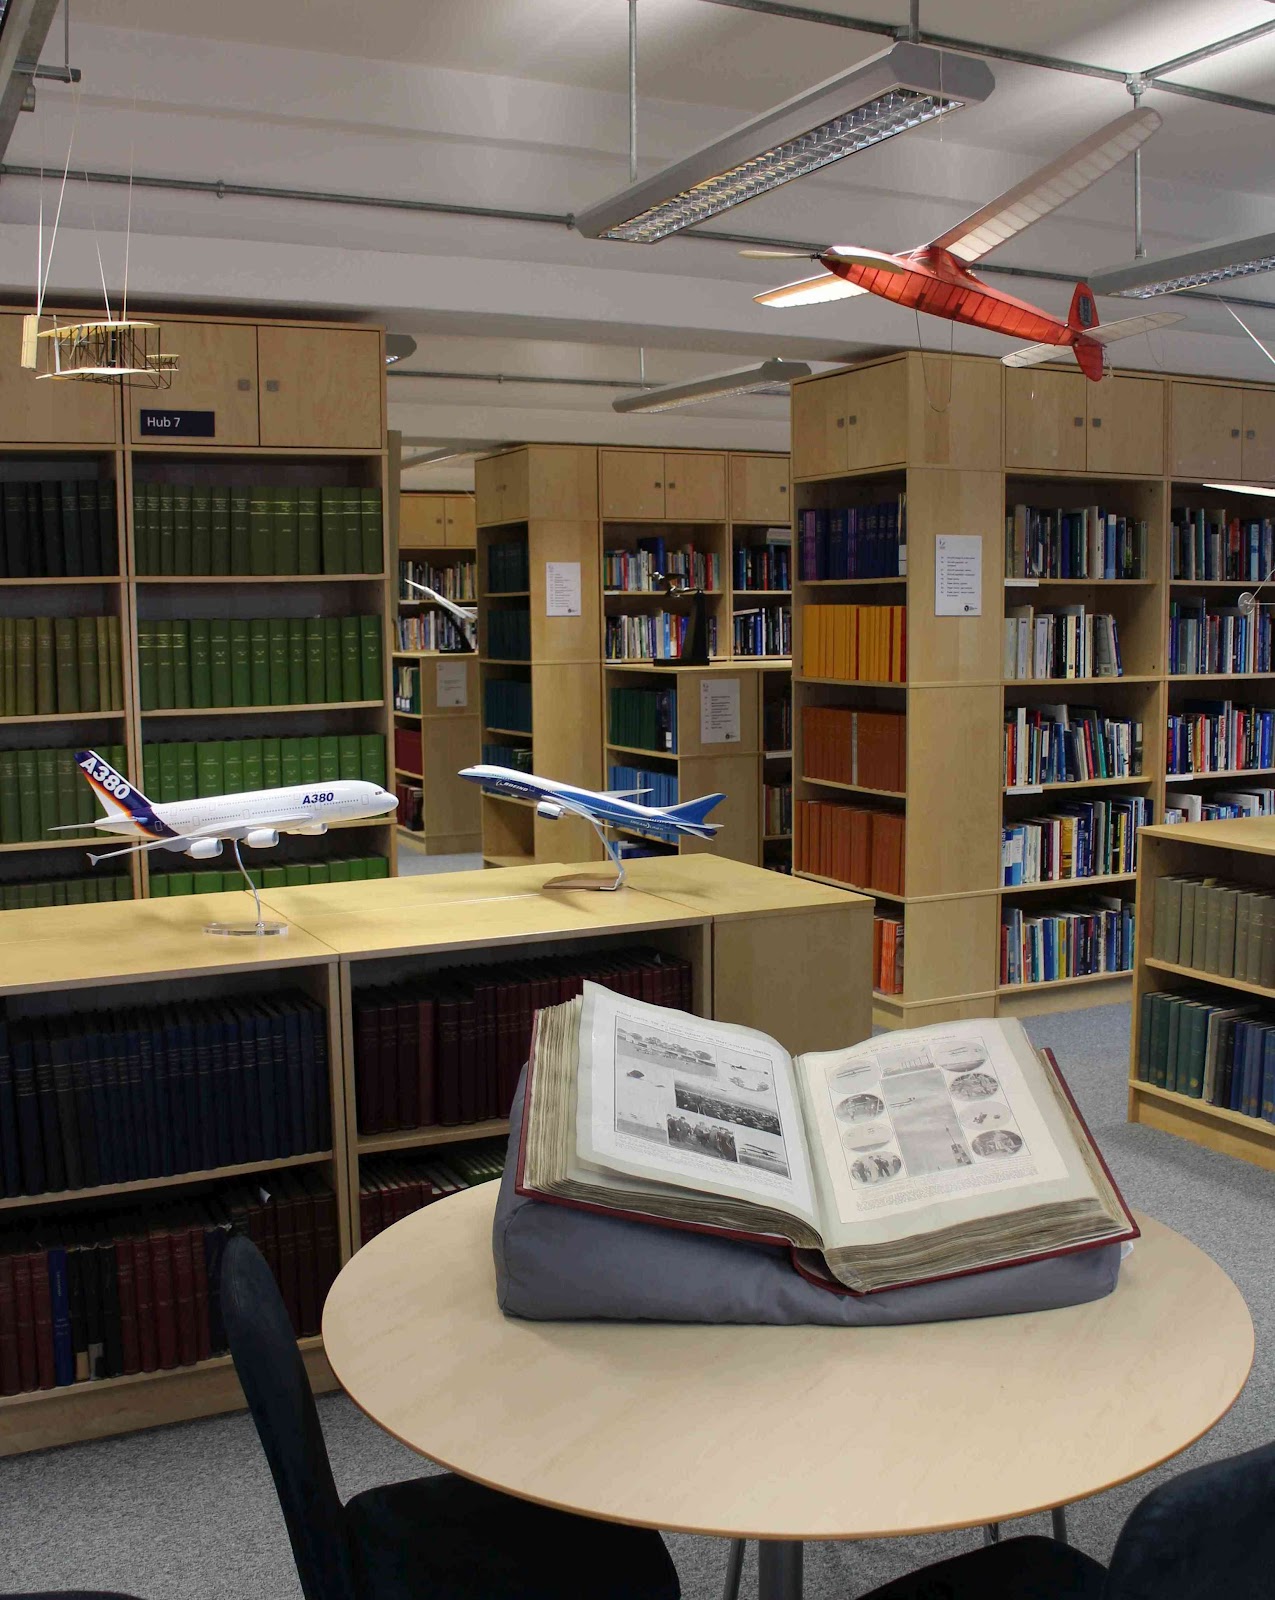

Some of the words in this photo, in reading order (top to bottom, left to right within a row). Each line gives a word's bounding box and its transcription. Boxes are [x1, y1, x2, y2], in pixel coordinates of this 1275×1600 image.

[147, 416, 171, 428] Hub
[173, 417, 181, 428] 7
[80, 757, 130, 800] A380
[503, 782, 529, 792] BOEING
[302, 792, 335, 805] A380
